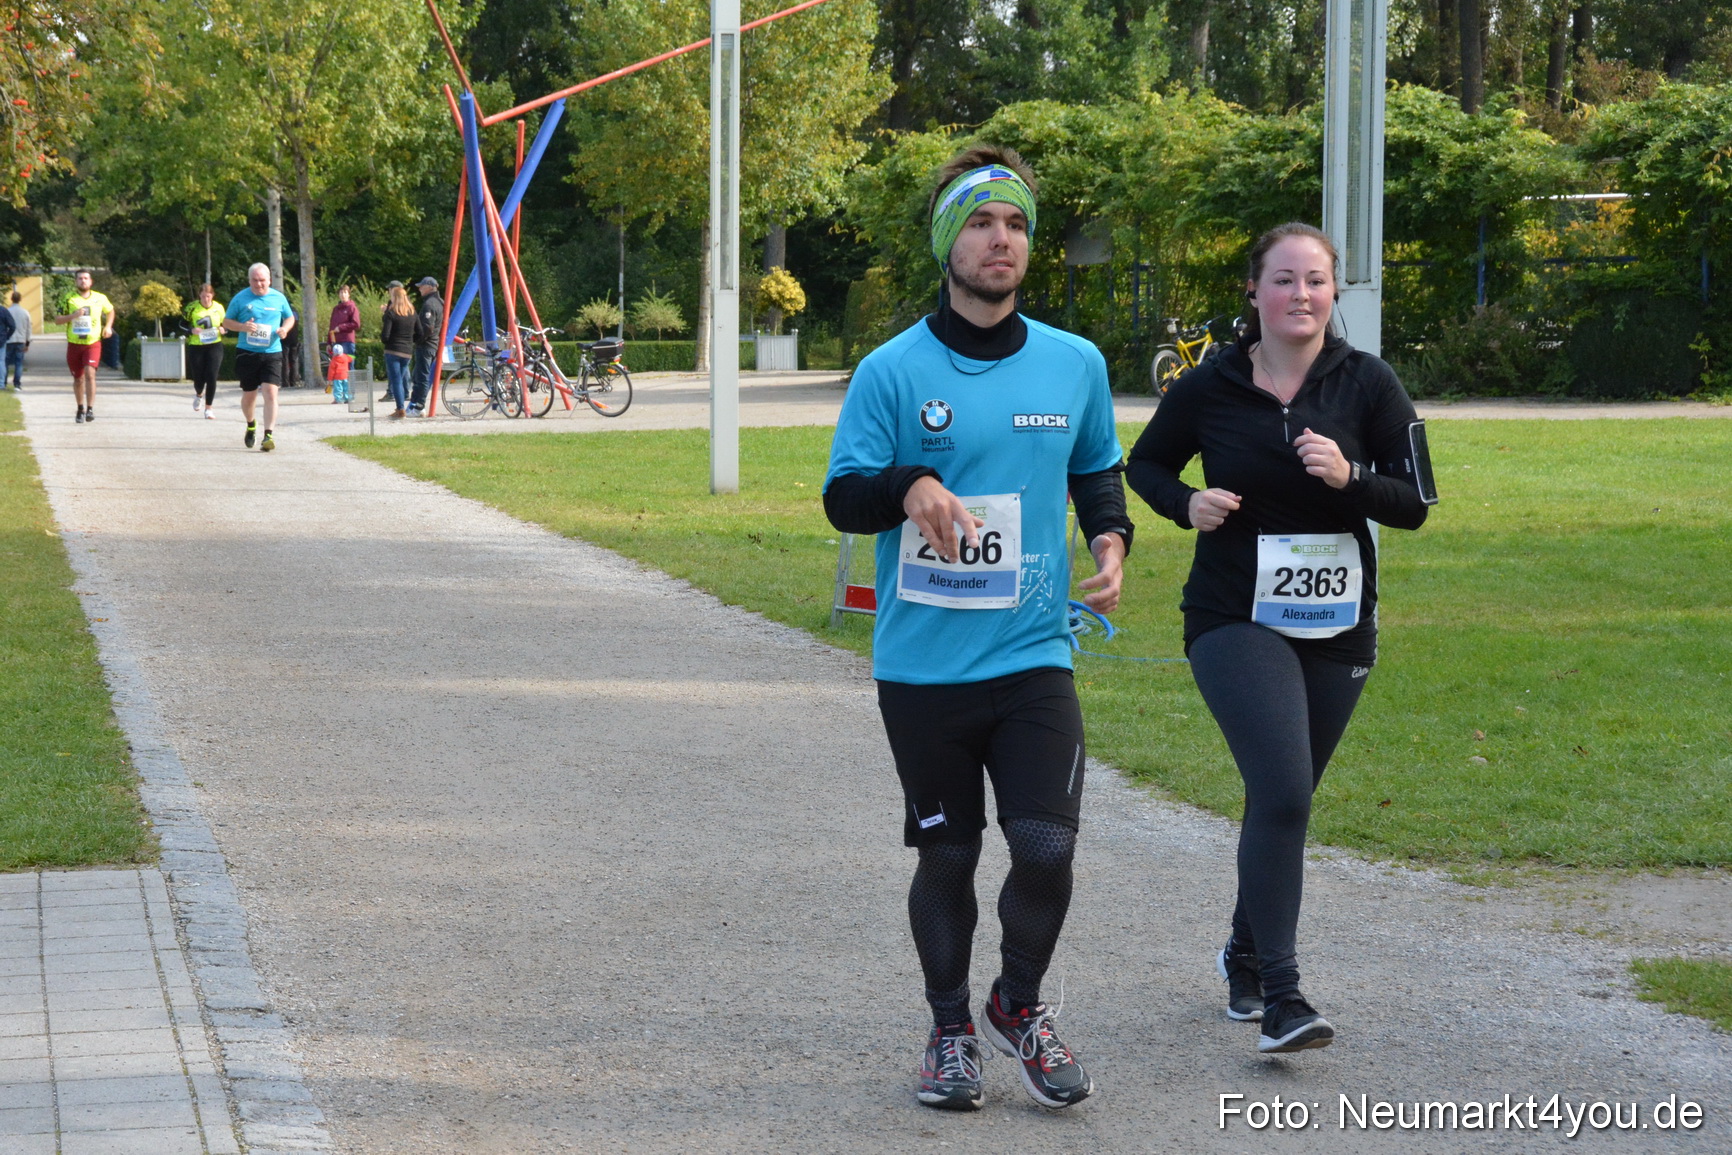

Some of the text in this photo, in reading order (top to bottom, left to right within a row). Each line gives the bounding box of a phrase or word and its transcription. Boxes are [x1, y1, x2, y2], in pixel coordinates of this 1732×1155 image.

[922, 401, 950, 412] BMW
[1013, 414, 1069, 428] BOCK
[921, 436, 955, 446] PARTL
[922, 445, 955, 453] Neumarkt
[917, 530, 1003, 565] 266
[1302, 544, 1339, 554] BOCK
[928, 573, 988, 589] Alexander
[1272, 567, 1348, 597] 2363
[1282, 608, 1335, 621] Alexandra
